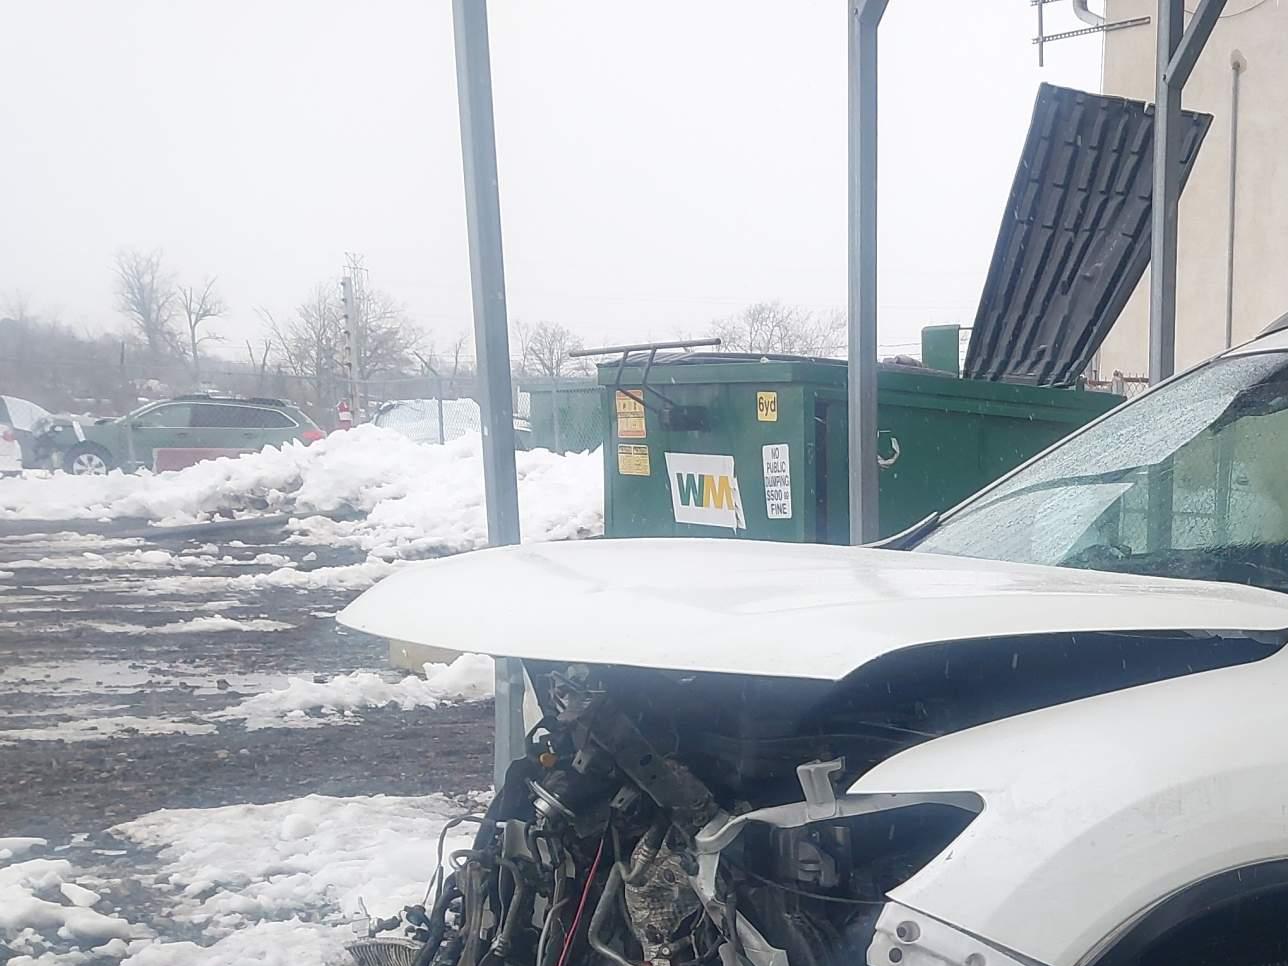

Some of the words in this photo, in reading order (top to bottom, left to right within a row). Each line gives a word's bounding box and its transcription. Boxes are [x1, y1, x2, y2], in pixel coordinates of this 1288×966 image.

[758, 396, 776, 417] 6yd
[770, 447, 780, 460] NO
[766, 461, 786, 474] PUBLIC
[765, 475, 789, 488] DUMPING
[675, 472, 735, 511] WM
[770, 503, 788, 516] FINE
